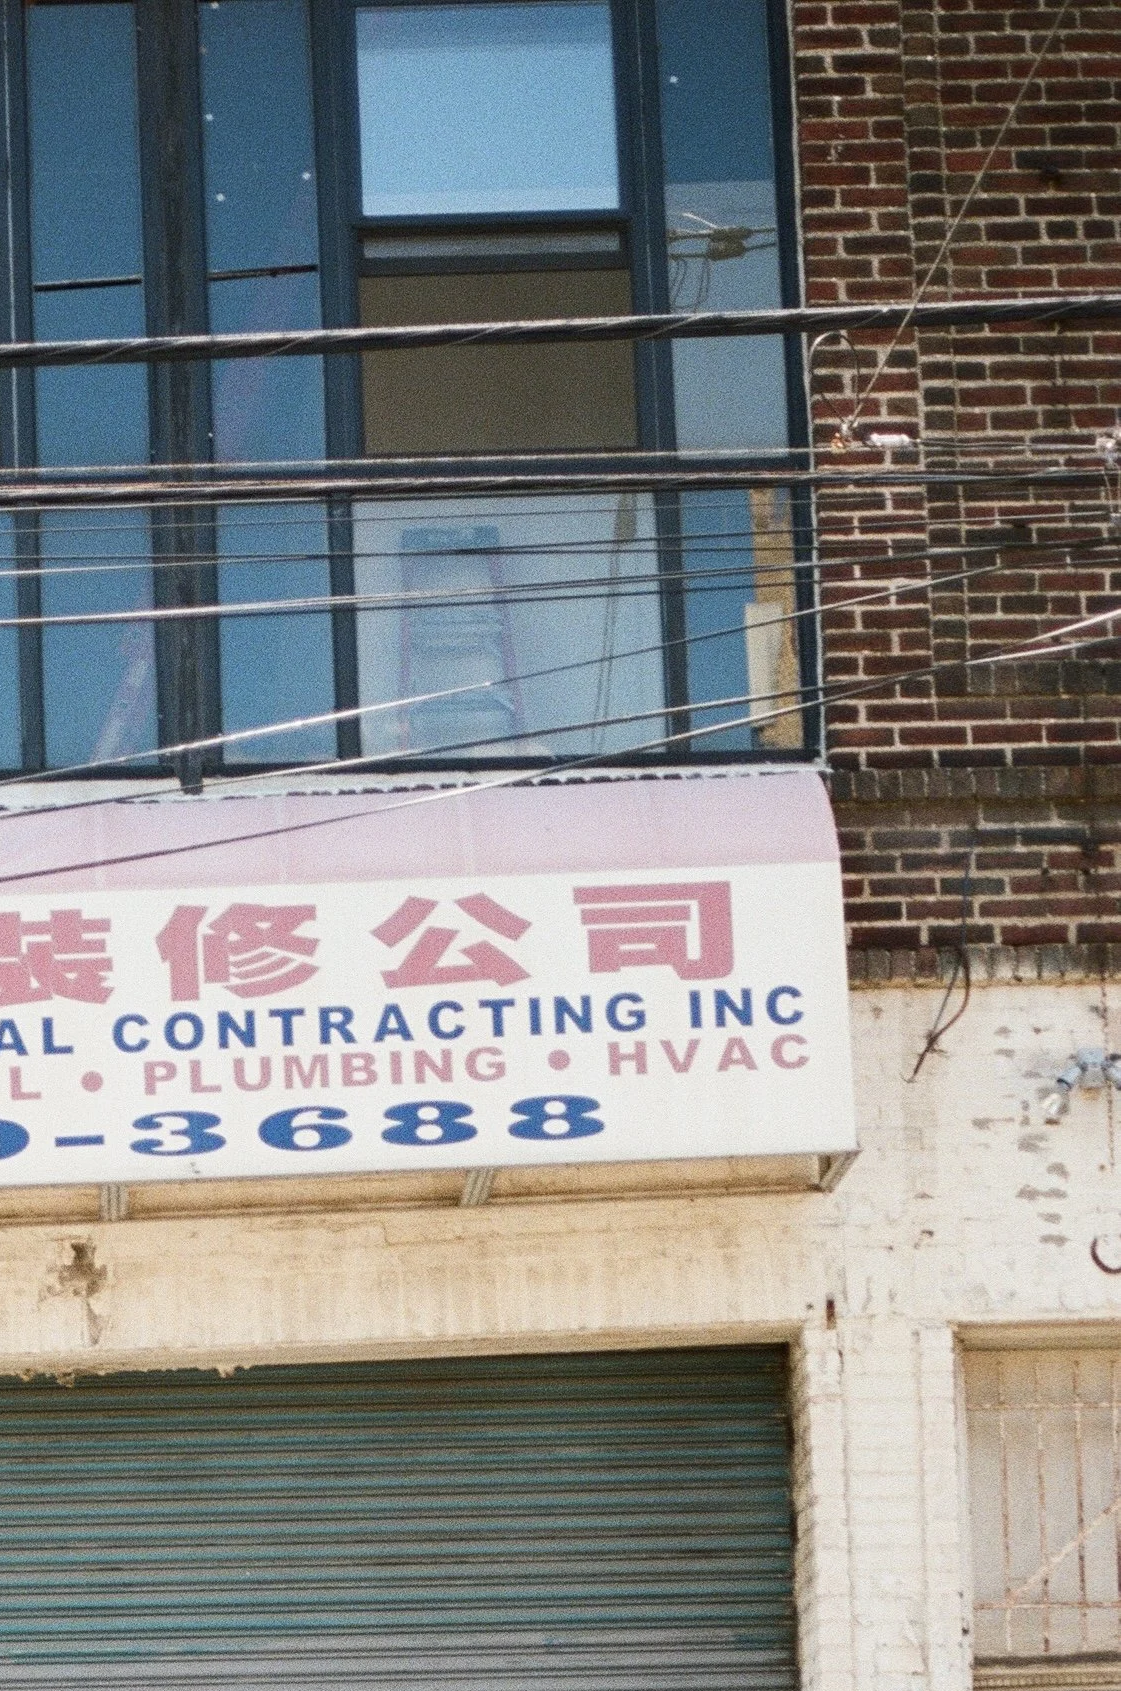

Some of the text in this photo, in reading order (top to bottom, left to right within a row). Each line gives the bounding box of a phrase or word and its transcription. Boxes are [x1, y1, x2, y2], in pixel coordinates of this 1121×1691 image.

[112, 994, 648, 1053] CONTRACTING
[689, 986, 805, 1028] INC
[143, 1045, 508, 1096] PLUMBING
[607, 1032, 812, 1076] HVAC
